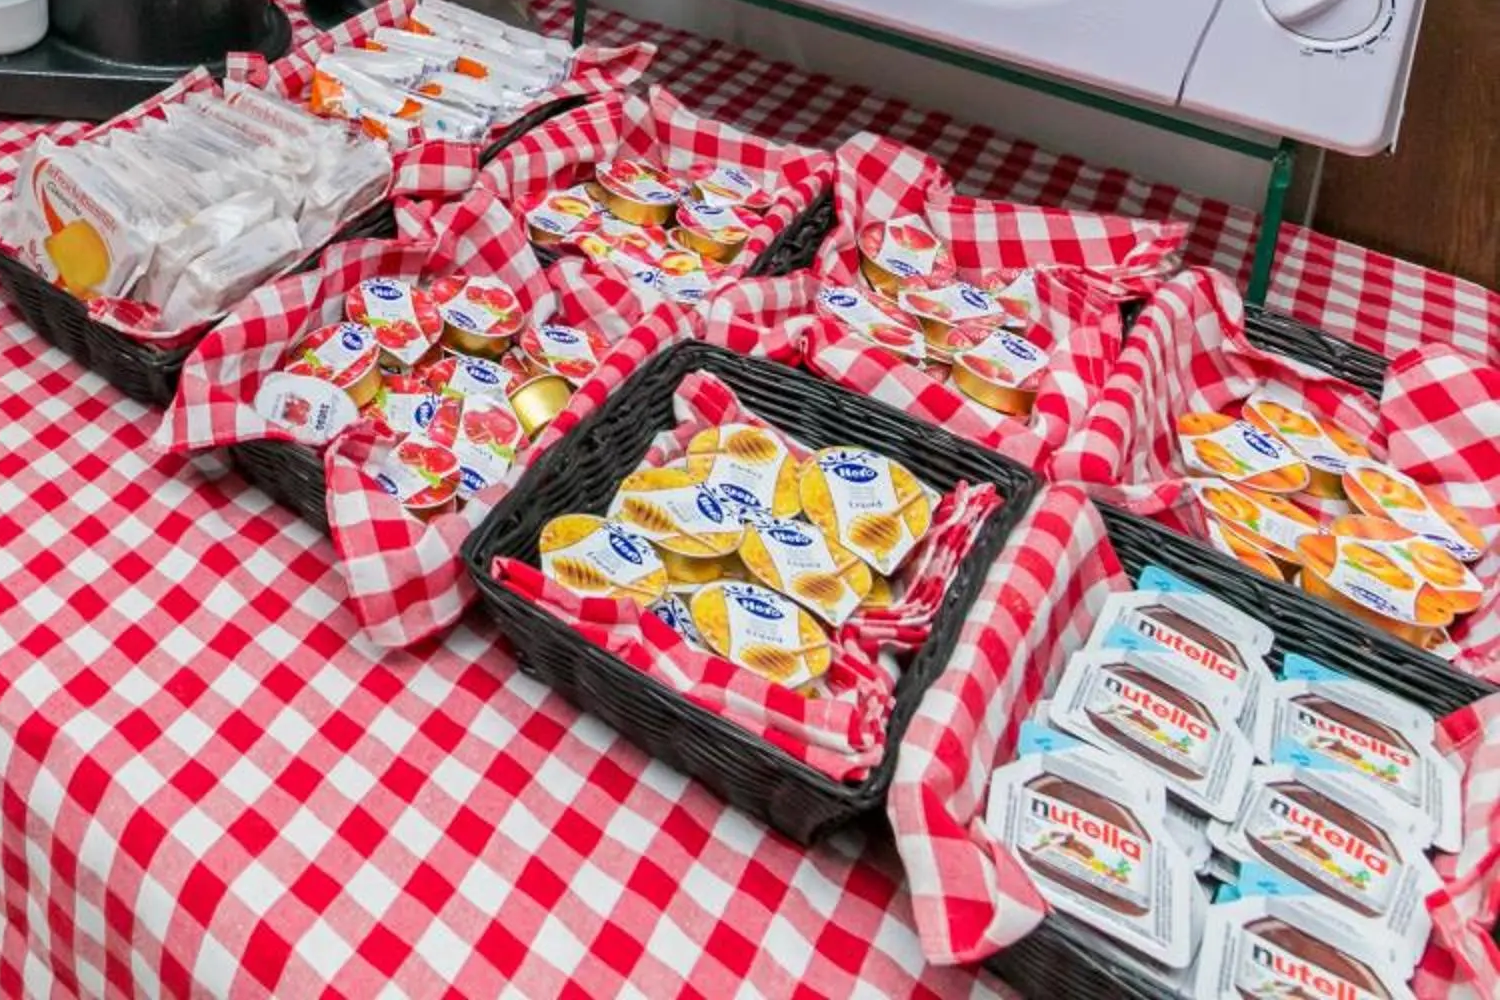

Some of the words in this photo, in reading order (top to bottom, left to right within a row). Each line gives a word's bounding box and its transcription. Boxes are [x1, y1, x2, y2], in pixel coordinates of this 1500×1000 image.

[1139, 619, 1238, 681] nutella
[1105, 677, 1208, 740] nutella
[1298, 710, 1411, 767] nutella
[1031, 797, 1142, 862] nutella
[1269, 797, 1389, 876] nutella
[1253, 943, 1360, 1000] nutell
